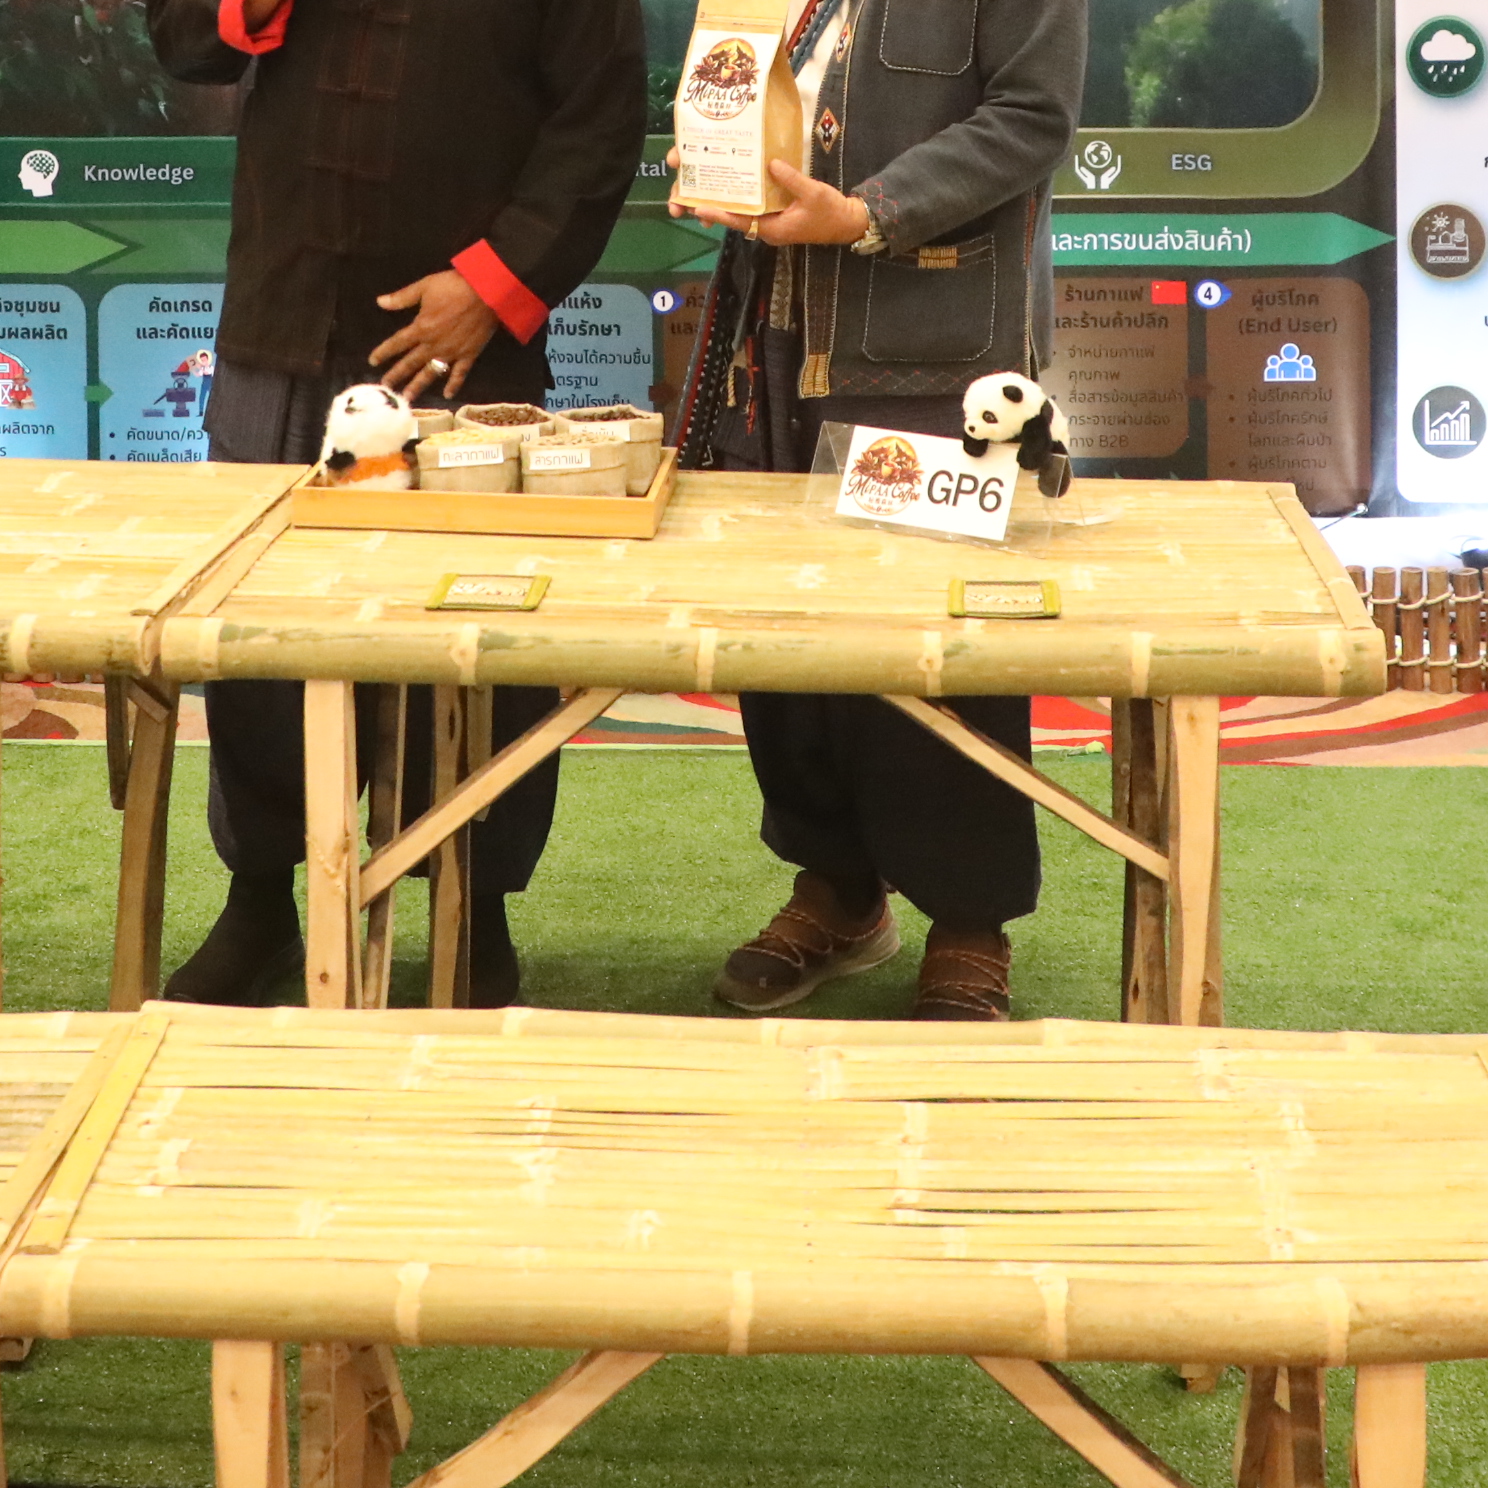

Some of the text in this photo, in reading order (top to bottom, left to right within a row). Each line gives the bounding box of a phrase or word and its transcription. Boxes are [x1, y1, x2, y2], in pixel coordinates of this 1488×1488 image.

[1171, 153, 1213, 171] ESG
[84, 162, 194, 185] Knowledge
[1203, 287, 1213, 301] 4
[1238, 317, 1339, 335] (End User)
[927, 469, 1005, 513] GP6
